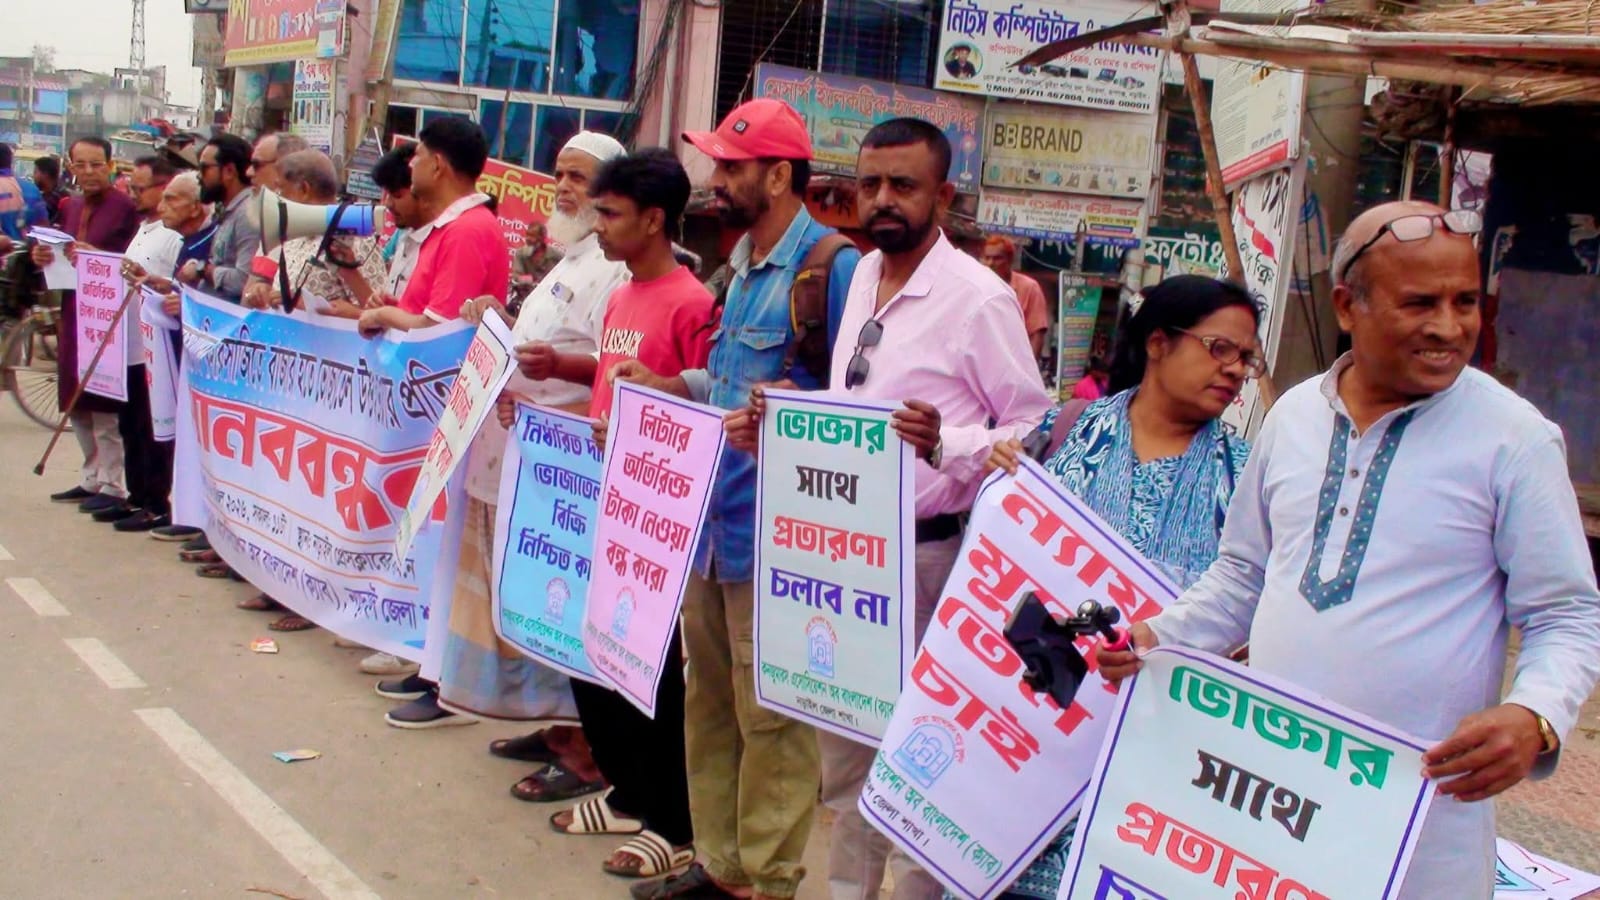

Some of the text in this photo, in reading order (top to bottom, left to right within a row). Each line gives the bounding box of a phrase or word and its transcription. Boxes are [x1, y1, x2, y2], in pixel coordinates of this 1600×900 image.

[1020, 125, 1083, 153] BRAND
[522, 415, 605, 464] নির্ধারিত দা
[639, 404, 693, 454] লিটারে
[777, 408, 888, 455] ভোক্তার
[190, 393, 449, 533] ানববন্ধন
[623, 452, 695, 499] অতিরিক্ত
[796, 465, 859, 505] সাথে
[552, 499, 587, 537] বিক্রি
[604, 485, 691, 552] টাকা নেওয়া
[773, 515, 887, 568] প্রতারণা
[517, 527, 573, 571] নিশ্চিত
[607, 540, 631, 577] বন্ধ
[770, 567, 891, 626] চলবে না
[911, 646, 1041, 774] চাই
[1169, 666, 1394, 790] ভোক্তার
[1191, 748, 1322, 843] সাথে
[922, 800, 970, 849] বাংলাদেশ
[1116, 802, 1335, 900] প্রতার
